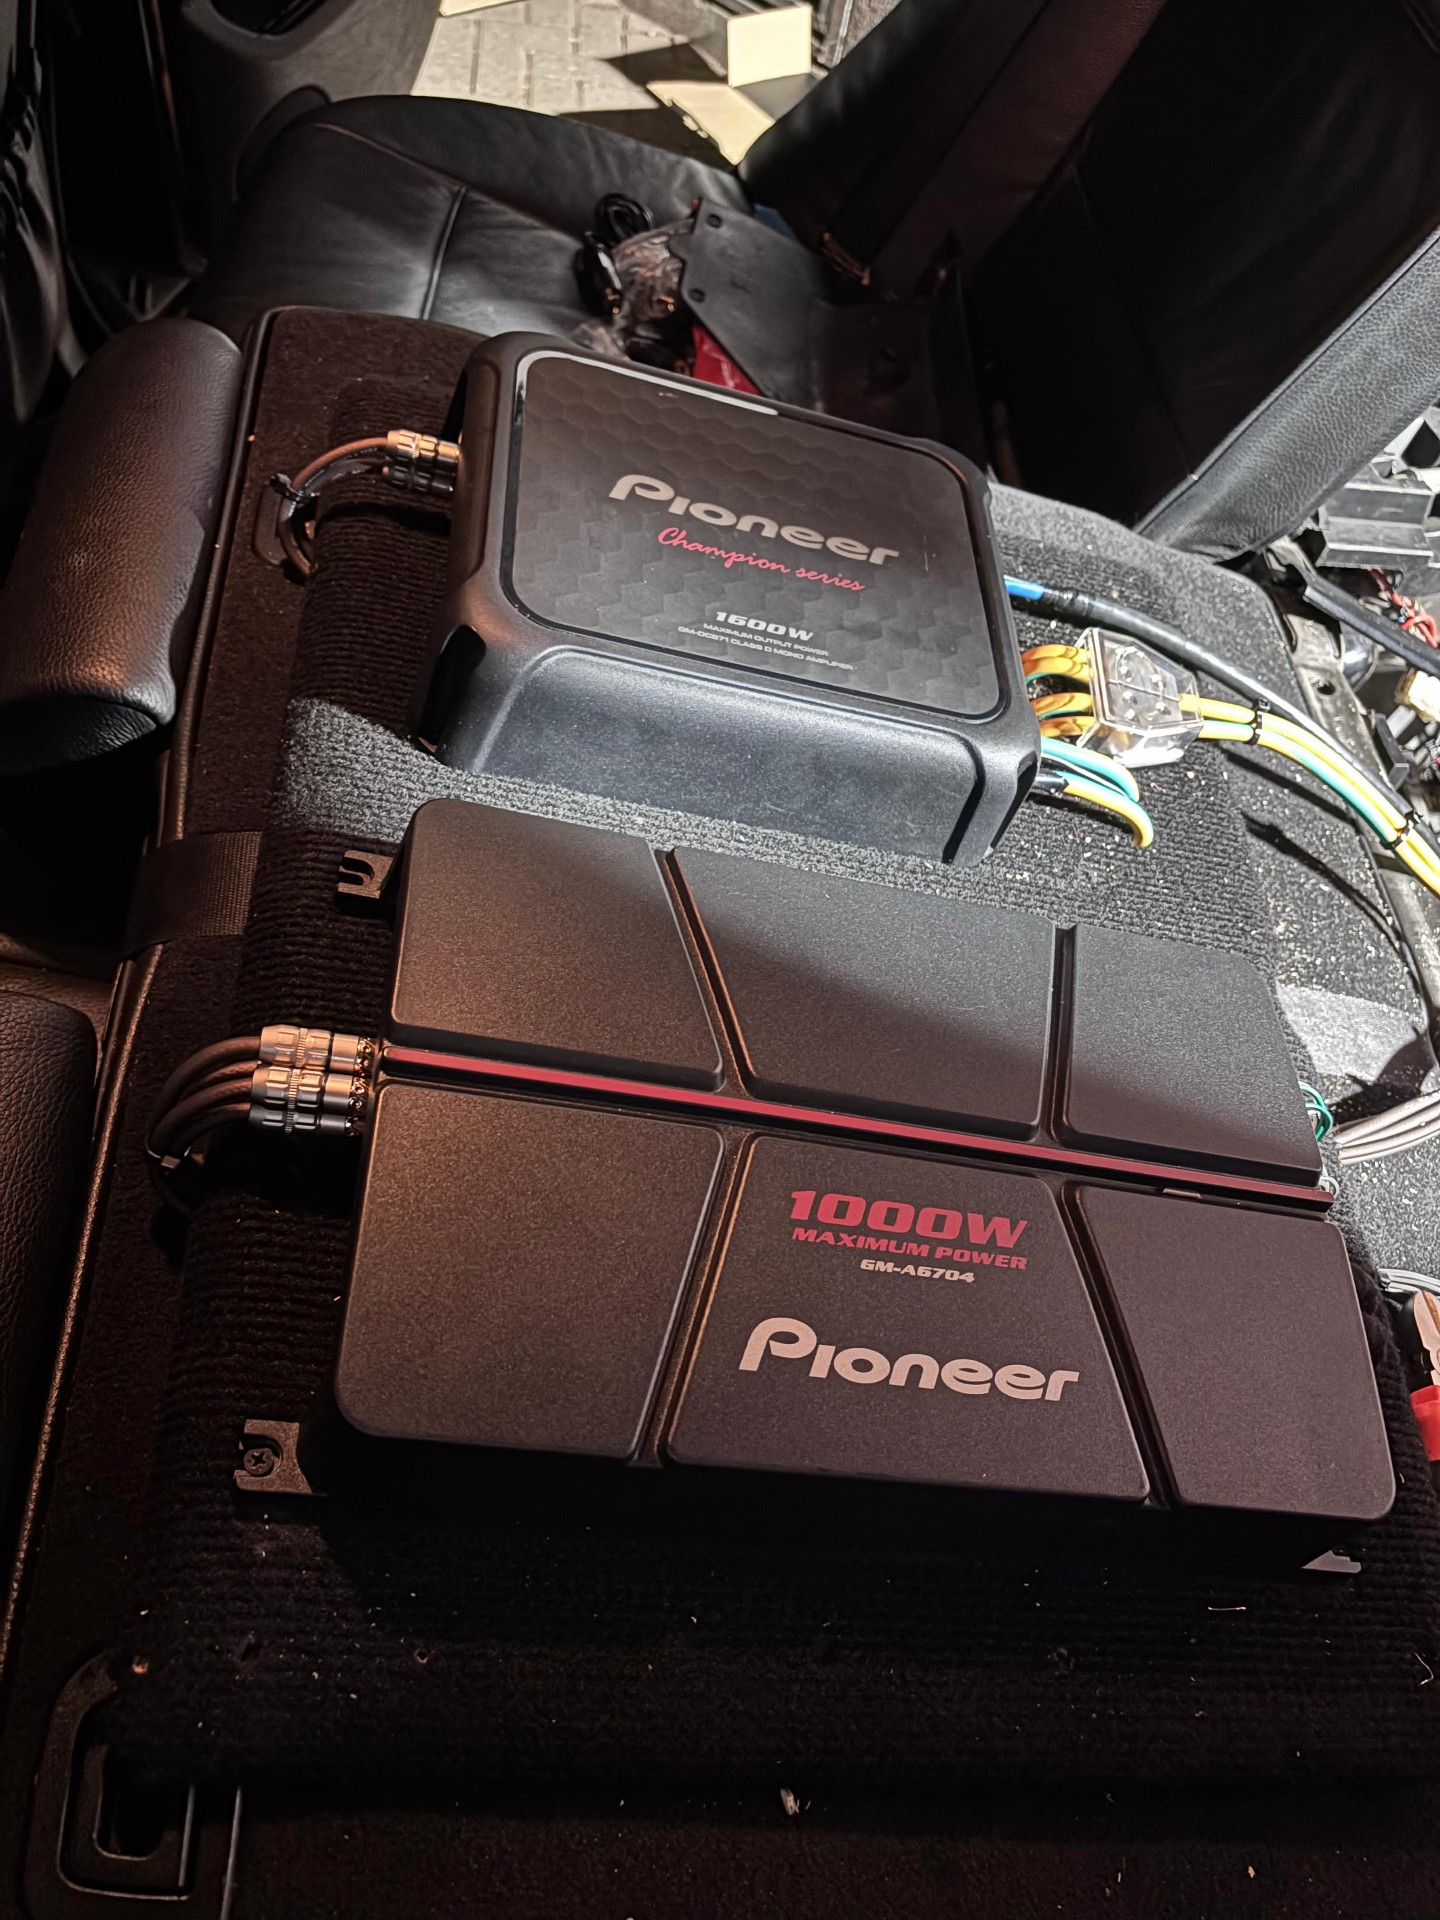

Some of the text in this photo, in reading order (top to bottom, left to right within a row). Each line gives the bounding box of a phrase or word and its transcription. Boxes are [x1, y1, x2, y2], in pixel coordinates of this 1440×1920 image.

[608, 474, 900, 565] Pioneer
[657, 527, 865, 591] Champion series
[703, 623, 829, 656] MAXIMUM OUTPUT POWER
[716, 611, 814, 641] 1600W
[730, 638, 763, 651] CLASS
[790, 1190, 1028, 1249] 1000W
[792, 1227, 1028, 1270] MAXIMUM POWER
[860, 1259, 975, 1283] GM-A6704
[739, 1317, 1080, 1401] Pioneer
